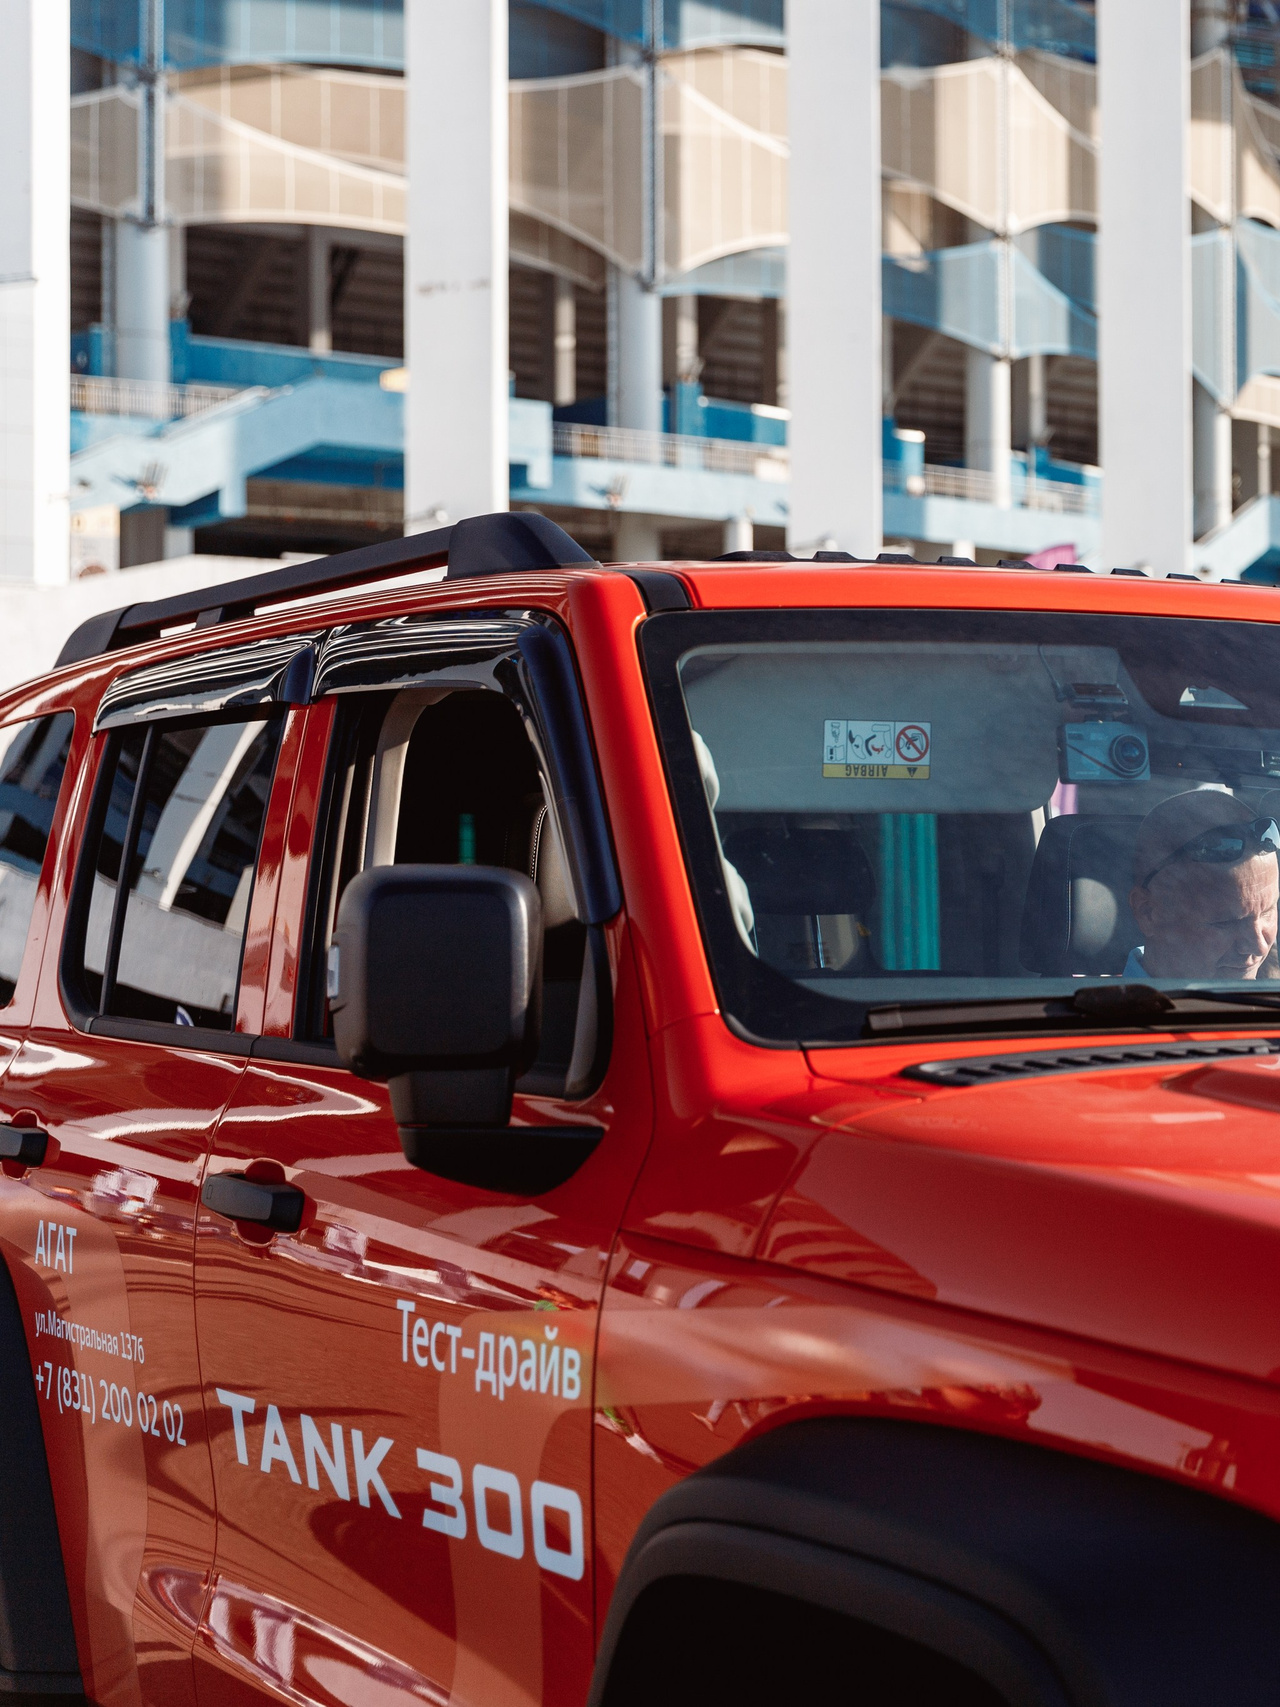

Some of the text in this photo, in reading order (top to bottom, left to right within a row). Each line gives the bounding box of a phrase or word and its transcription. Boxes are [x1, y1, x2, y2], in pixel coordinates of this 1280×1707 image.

[845, 765, 888, 777] AIRBAG
[35, 1219, 77, 1274] АГАТ
[35, 1309, 119, 1356] ул.Магистральная
[396, 1299, 581, 1401] Тест-драйв
[35, 1361, 187, 1447] +7 (831) 200 02 02
[216, 1387, 585, 1581] TANK 300
